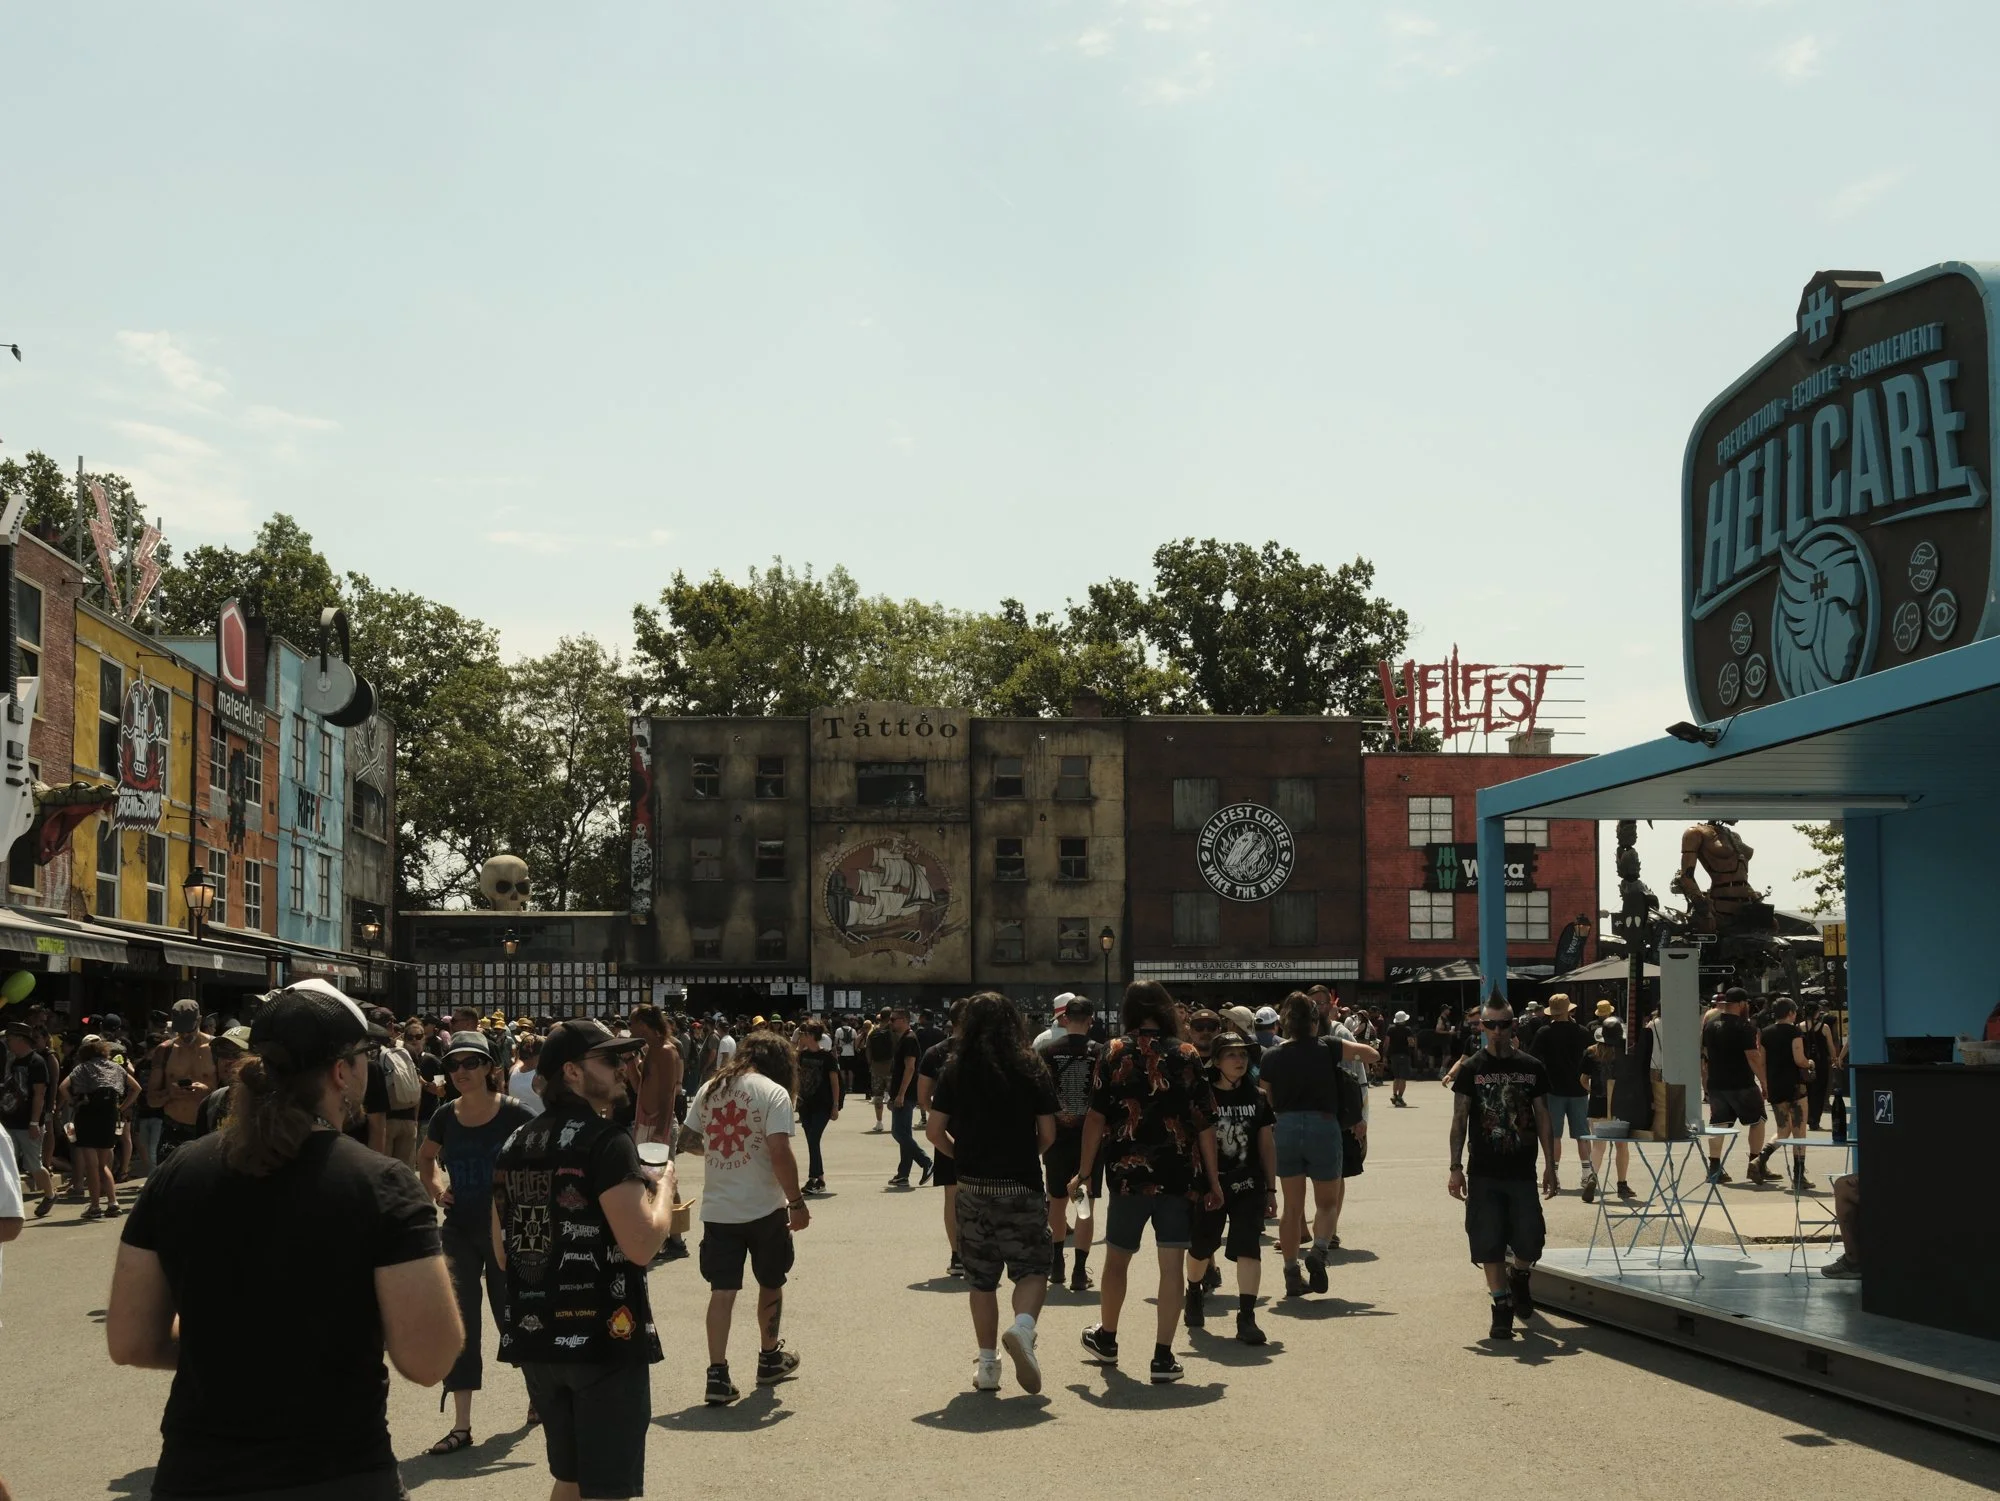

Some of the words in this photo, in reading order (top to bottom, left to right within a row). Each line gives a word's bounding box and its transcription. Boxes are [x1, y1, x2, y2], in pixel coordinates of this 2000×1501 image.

[1717, 398, 1783, 466] PREVENTION
[1849, 321, 1944, 380] SIGNALEMENT
[1379, 642, 1566, 744] HELLFEST
[218, 690, 266, 733] materiel.net
[822, 717, 958, 740] Tattoo
[1201, 807, 1253, 848] HELLFEST
[1254, 809, 1291, 849] COFFEE
[1462, 858, 1525, 879] Wa
[1203, 863, 1232, 894] WAKE
[1235, 885, 1257, 899] THE
[1260, 862, 1290, 894] DEAD!
[1174, 961, 1258, 970] HELLBANGER'S
[1263, 961, 1298, 970] ROAST
[1195, 972, 1242, 980] PRE-PIT
[1250, 972, 1278, 980] FUEL
[1216, 1103, 1257, 1118] OLATION
[505, 1166, 554, 1204] HELLFEST
[559, 1250, 601, 1273] METALLICA
[555, 1310, 574, 1319] ULTRA
[575, 1309, 597, 1318] VOMIT
[553, 1334, 590, 1348] SKILLET
